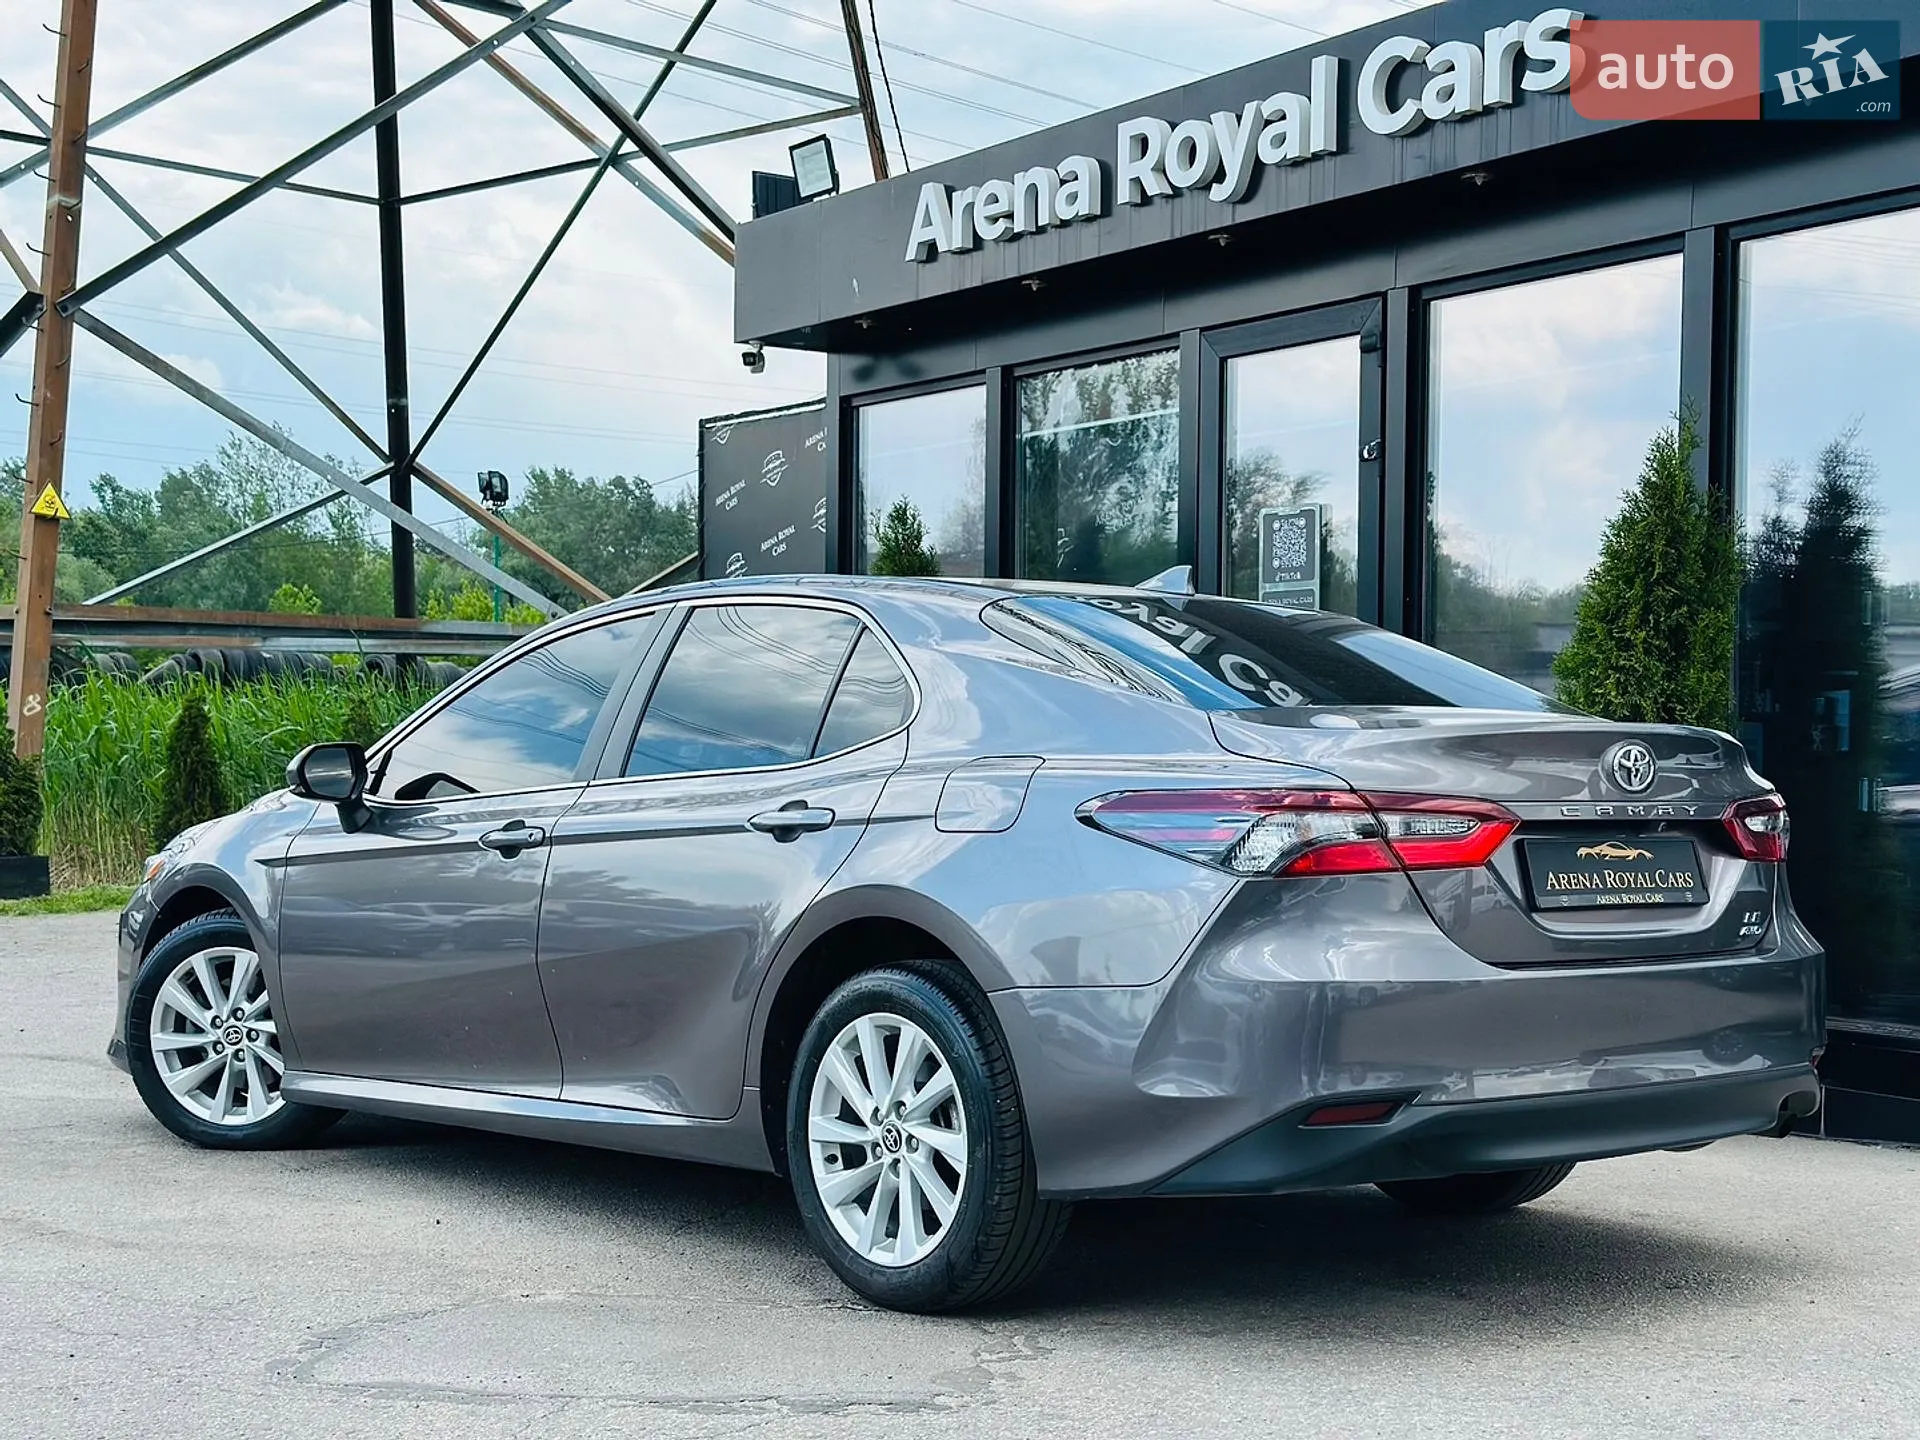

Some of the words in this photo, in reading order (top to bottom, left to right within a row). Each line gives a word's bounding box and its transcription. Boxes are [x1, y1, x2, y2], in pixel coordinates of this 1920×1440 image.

[905, 155, 1101, 262] Arena
[1117, 54, 1338, 204] Royal
[1357, 8, 1586, 136] Cars
[1560, 805, 1698, 817] CAMRY
[1546, 871, 1603, 890] ARENA
[1604, 869, 1655, 889] ROYAL
[1655, 869, 1695, 888] CARS
[1596, 894, 1620, 905] ARENA
[1621, 893, 1644, 904] ROYAL
[1645, 892, 1665, 903] CARS
